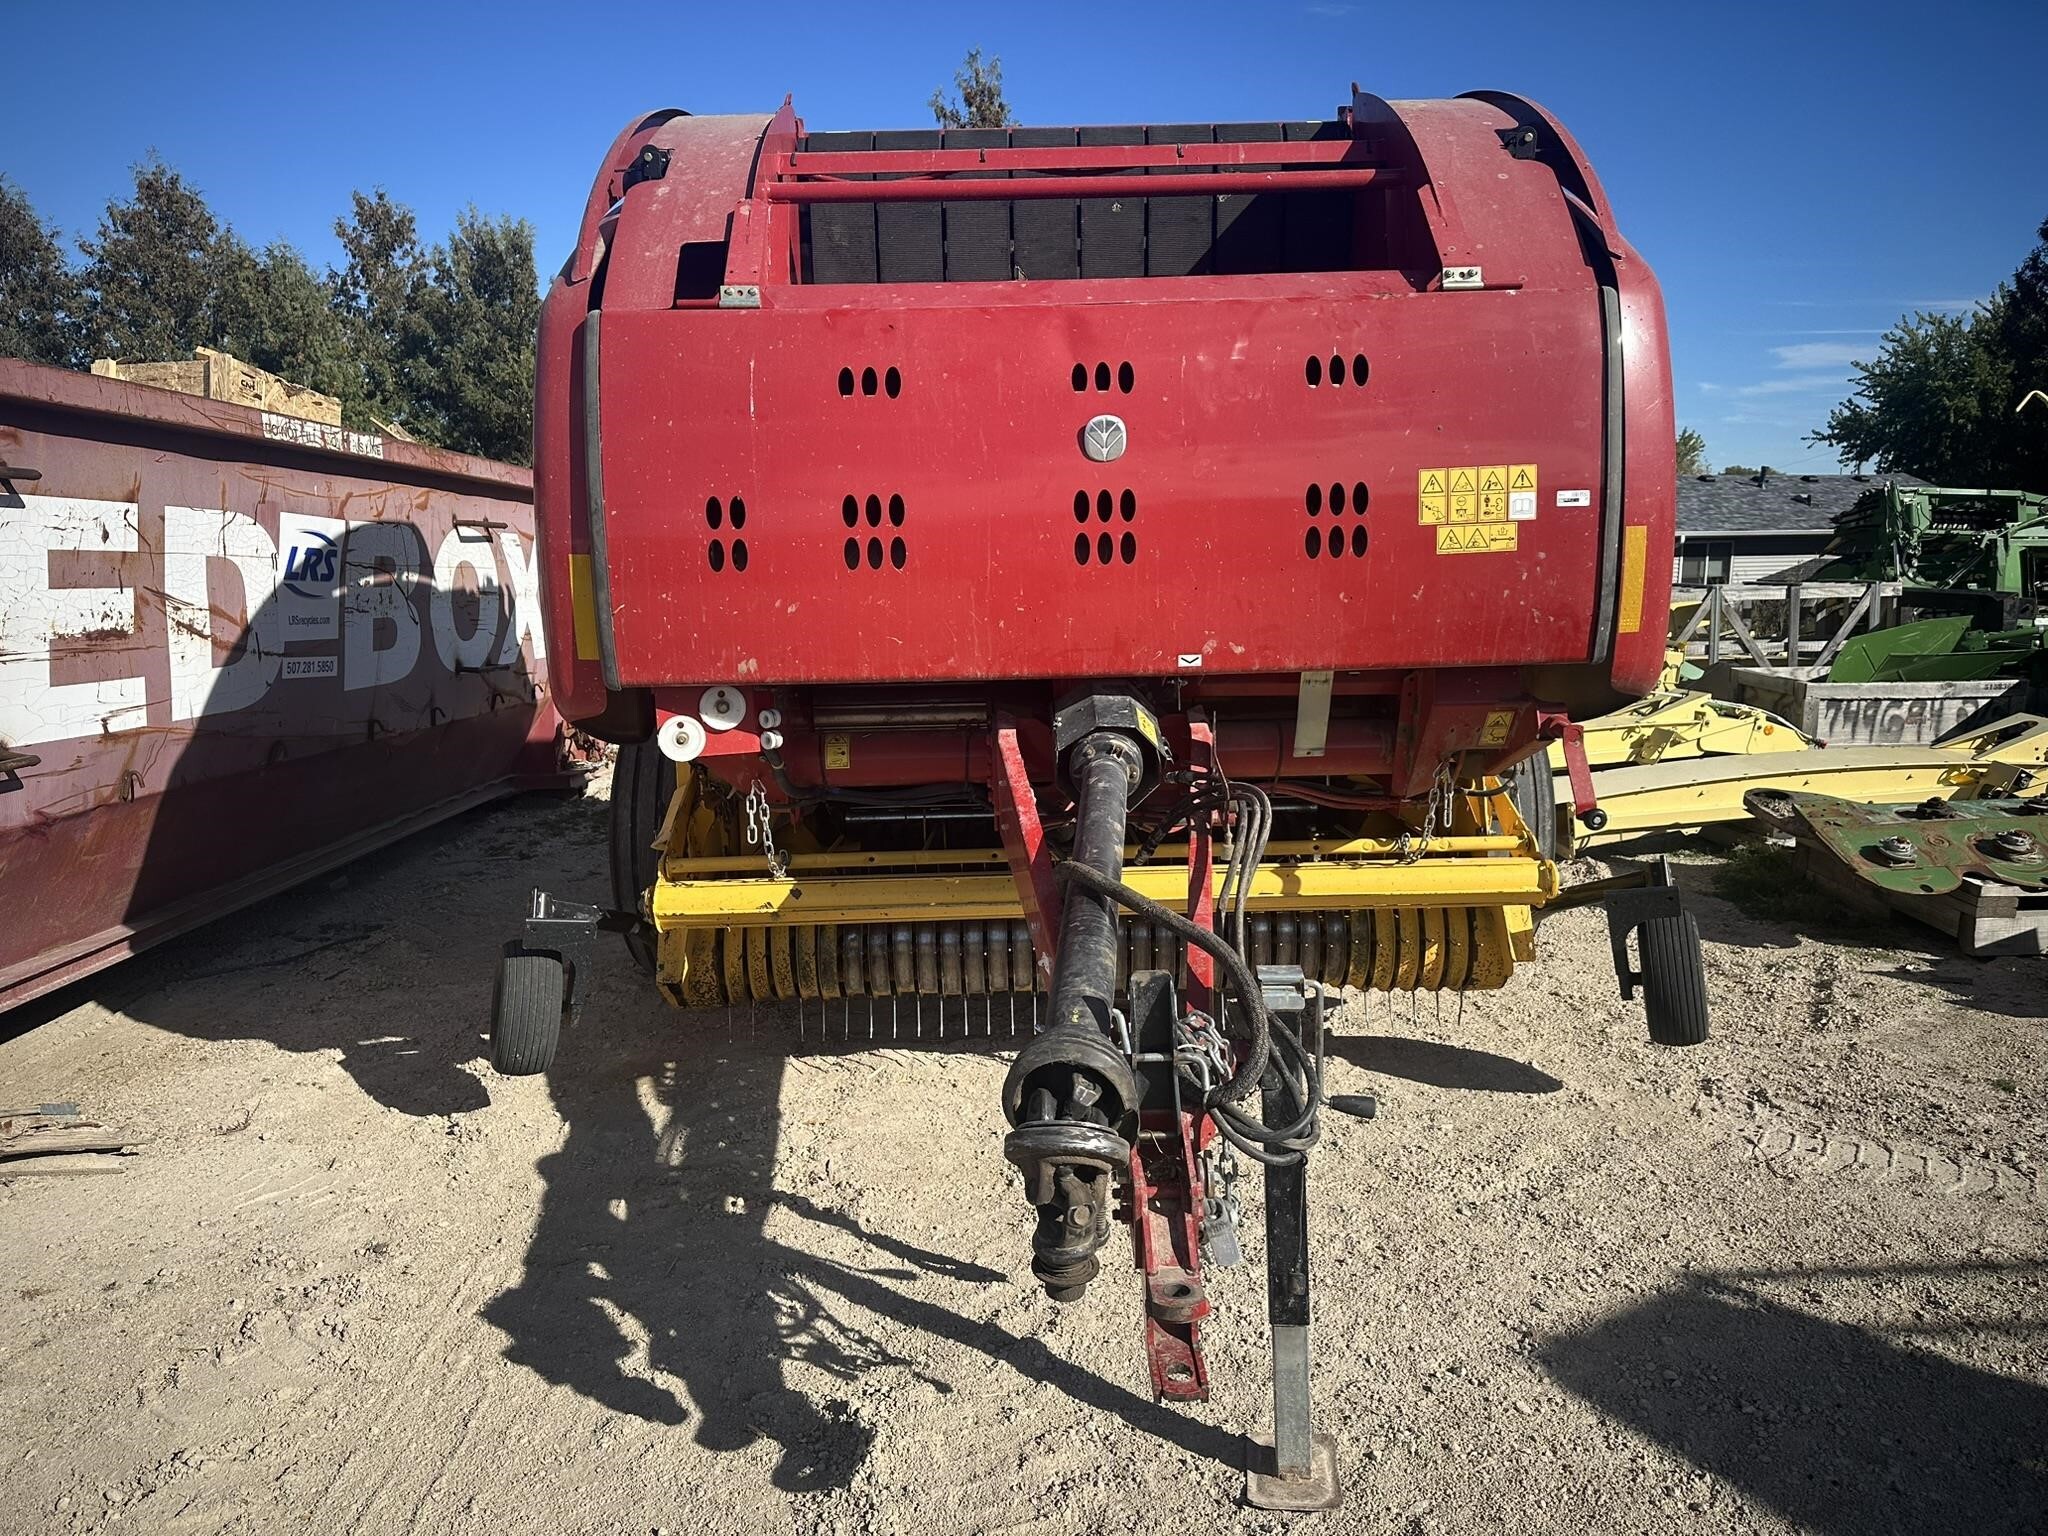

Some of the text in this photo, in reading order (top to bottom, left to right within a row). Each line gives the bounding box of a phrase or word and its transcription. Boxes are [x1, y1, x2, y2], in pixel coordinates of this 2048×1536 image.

[284, 546, 338, 582] LRS
[344, 520, 545, 692] BOX
[287, 661, 334, 675] 507.281.5850
